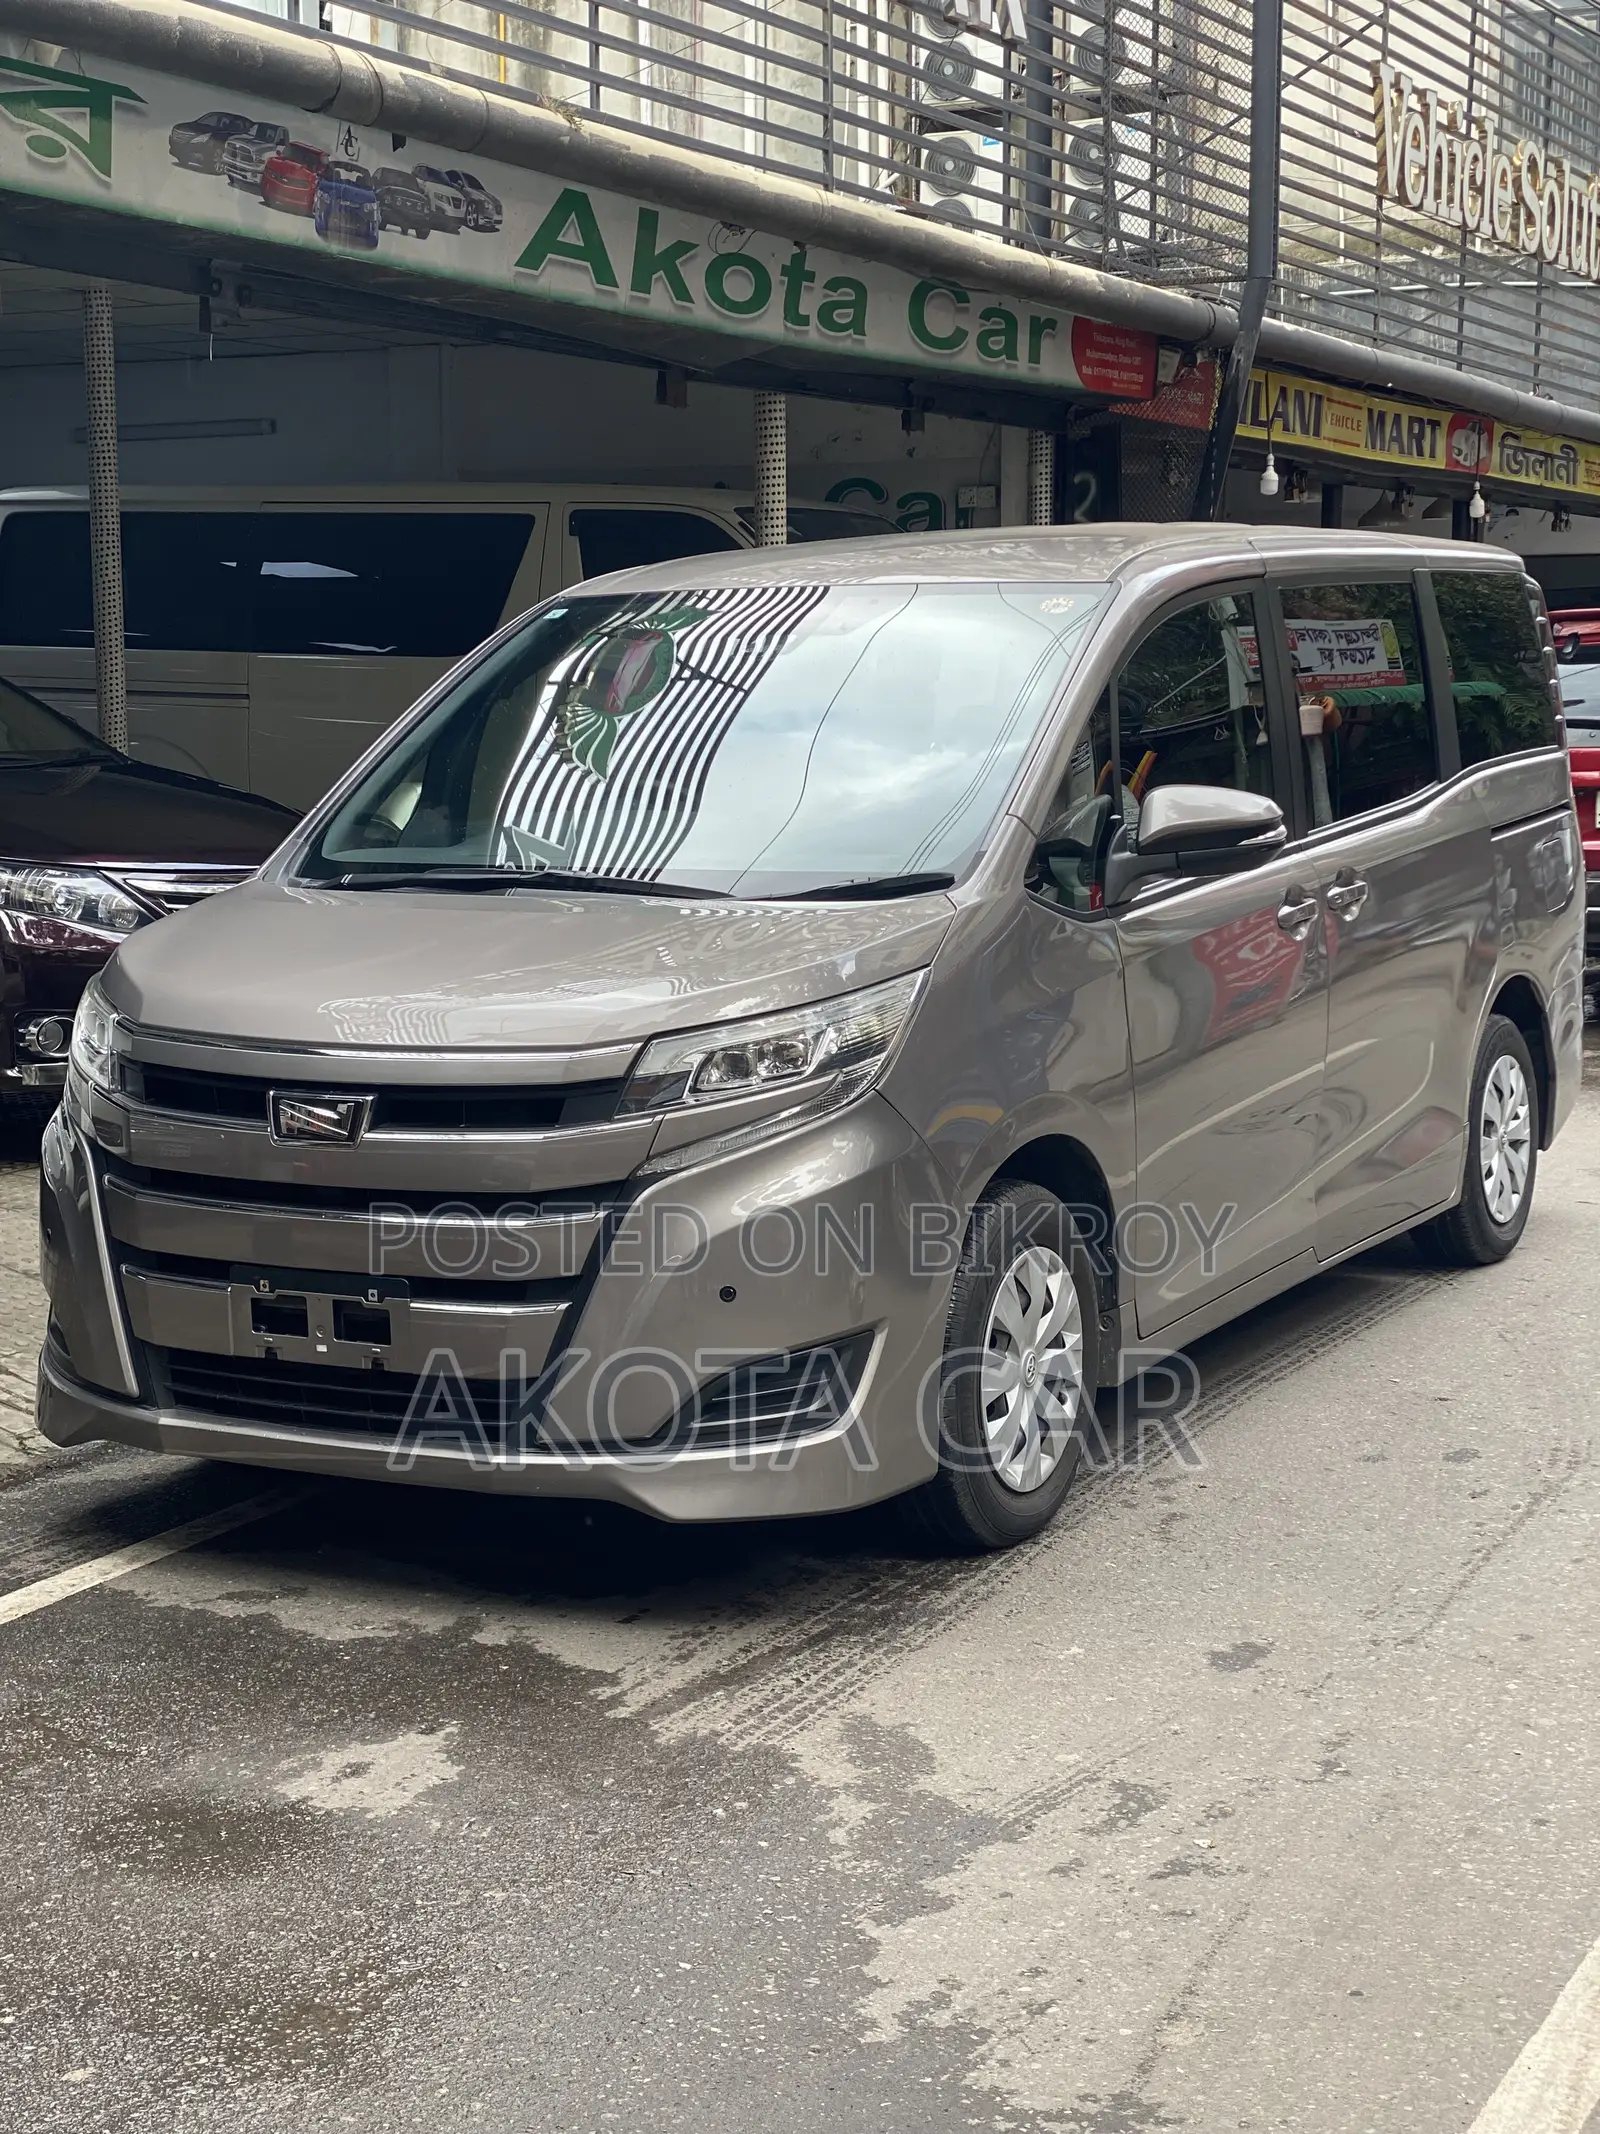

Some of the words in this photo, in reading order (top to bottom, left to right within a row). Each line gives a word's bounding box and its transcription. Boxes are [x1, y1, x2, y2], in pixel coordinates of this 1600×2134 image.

[513, 186, 869, 339] Akota
[907, 276, 1058, 367] Car
[1238, 379, 1325, 440] ILANI
[1325, 409, 1363, 433] VEHICLE
[1364, 406, 1442, 461] MART
[1498, 431, 1580, 486] জিলানী
